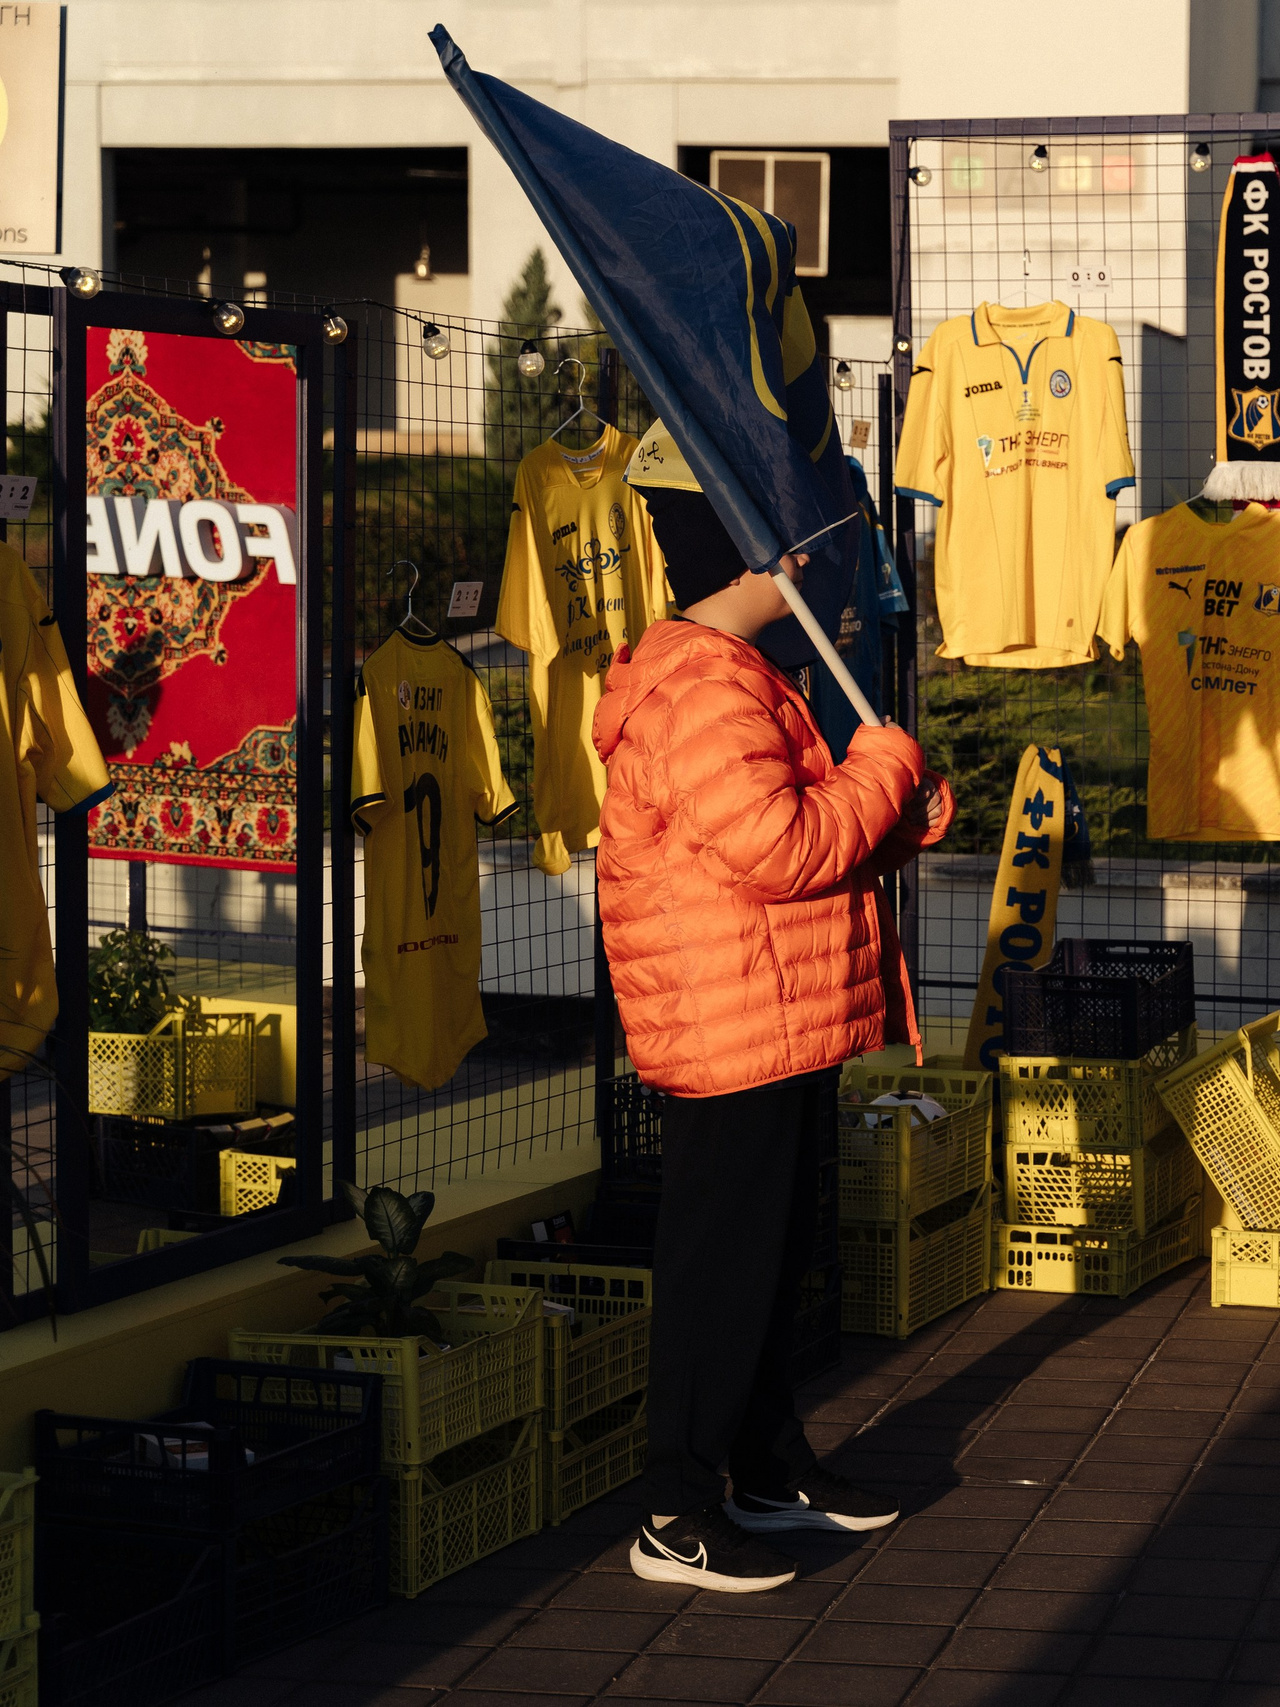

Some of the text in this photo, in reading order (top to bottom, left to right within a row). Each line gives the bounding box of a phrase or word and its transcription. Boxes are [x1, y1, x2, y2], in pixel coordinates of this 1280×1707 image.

[0, 227, 28, 244] ns
[1071, 271, 1080, 281] 0
[1098, 271, 1106, 281] 0
[1242, 178, 1271, 380] ФК РОСТОВ
[998, 430, 1069, 453] ТН ЭНЕРГ
[1203, 579, 1244, 599] FON
[1203, 598, 1240, 617] BET
[1228, 644, 1272, 662] ЭНЕРГО
[1012, 786, 1054, 869] ФК
